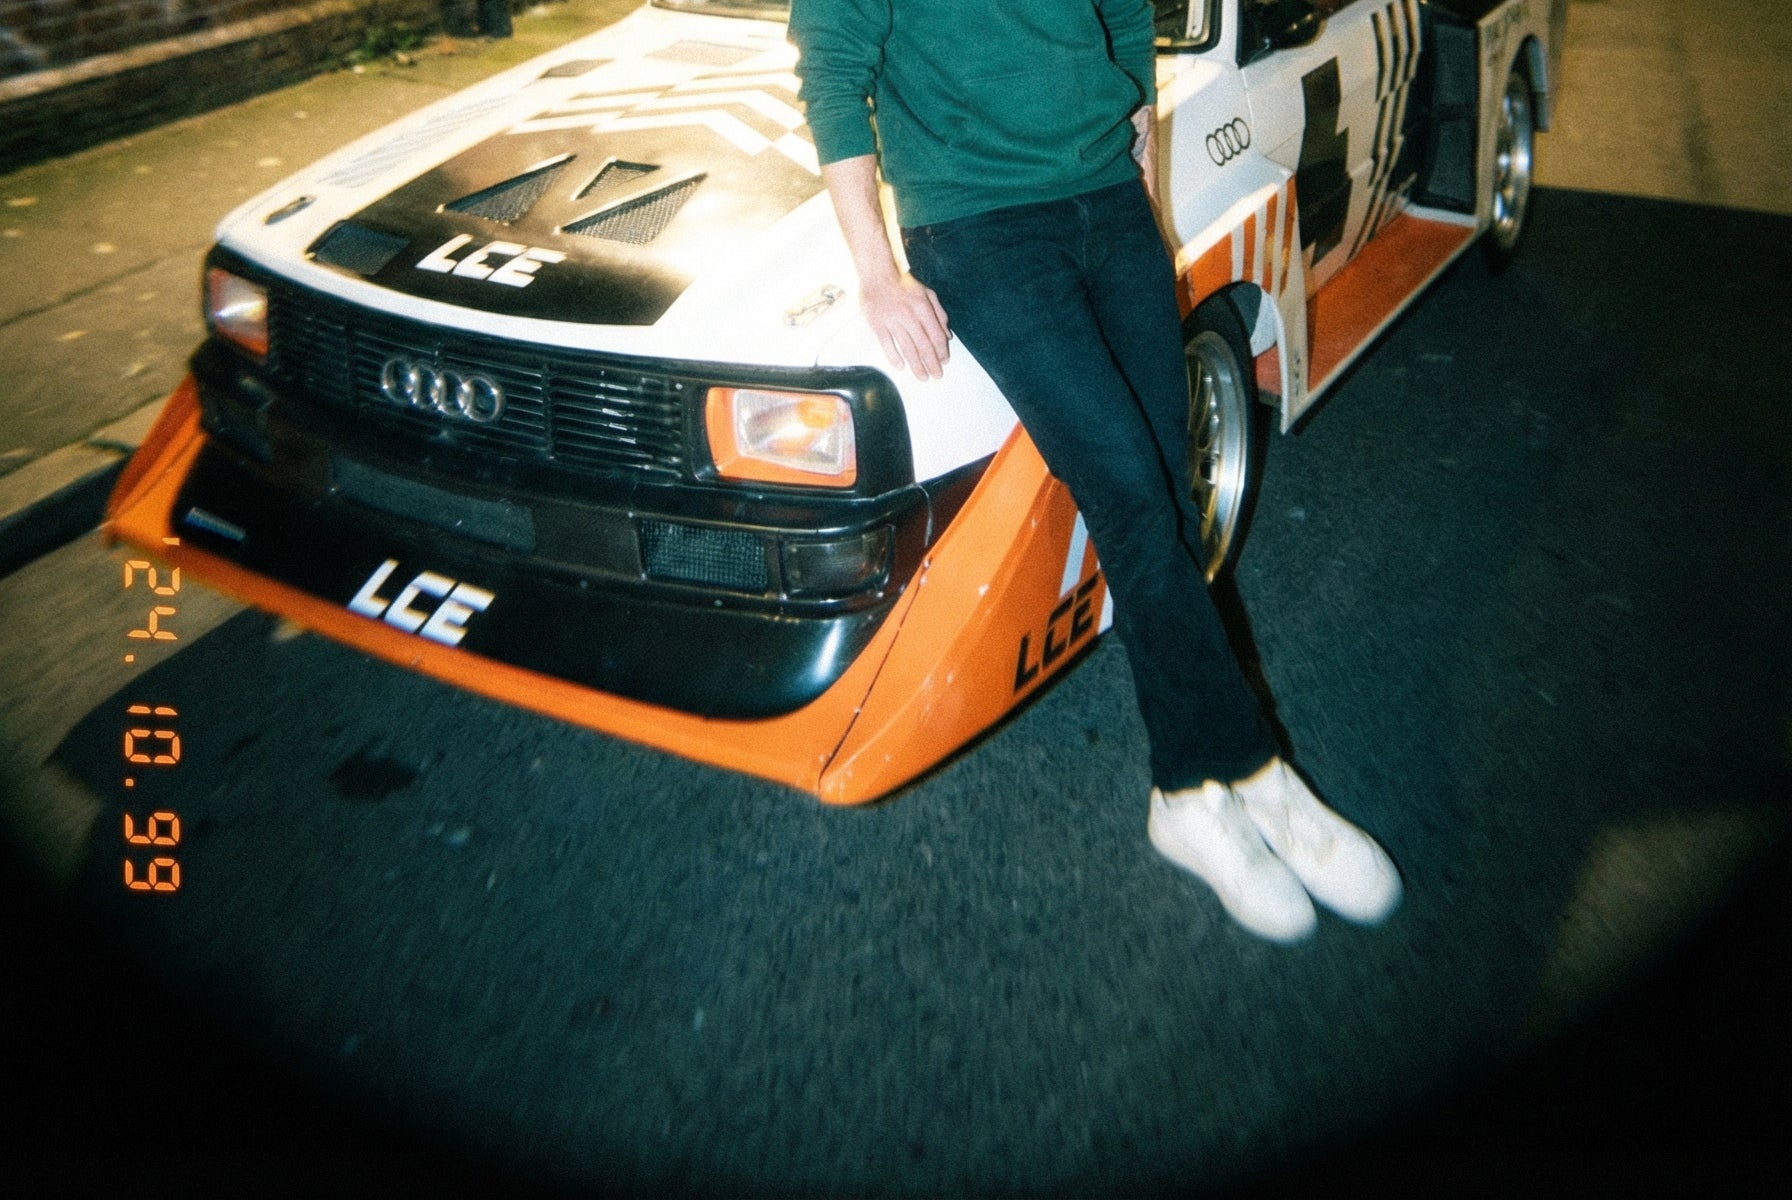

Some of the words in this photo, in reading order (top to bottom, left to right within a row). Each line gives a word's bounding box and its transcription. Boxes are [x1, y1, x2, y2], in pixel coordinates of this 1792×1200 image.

[415, 233, 567, 288] LCE
[347, 558, 495, 647] LCE
[1013, 569, 1100, 694] LCE
